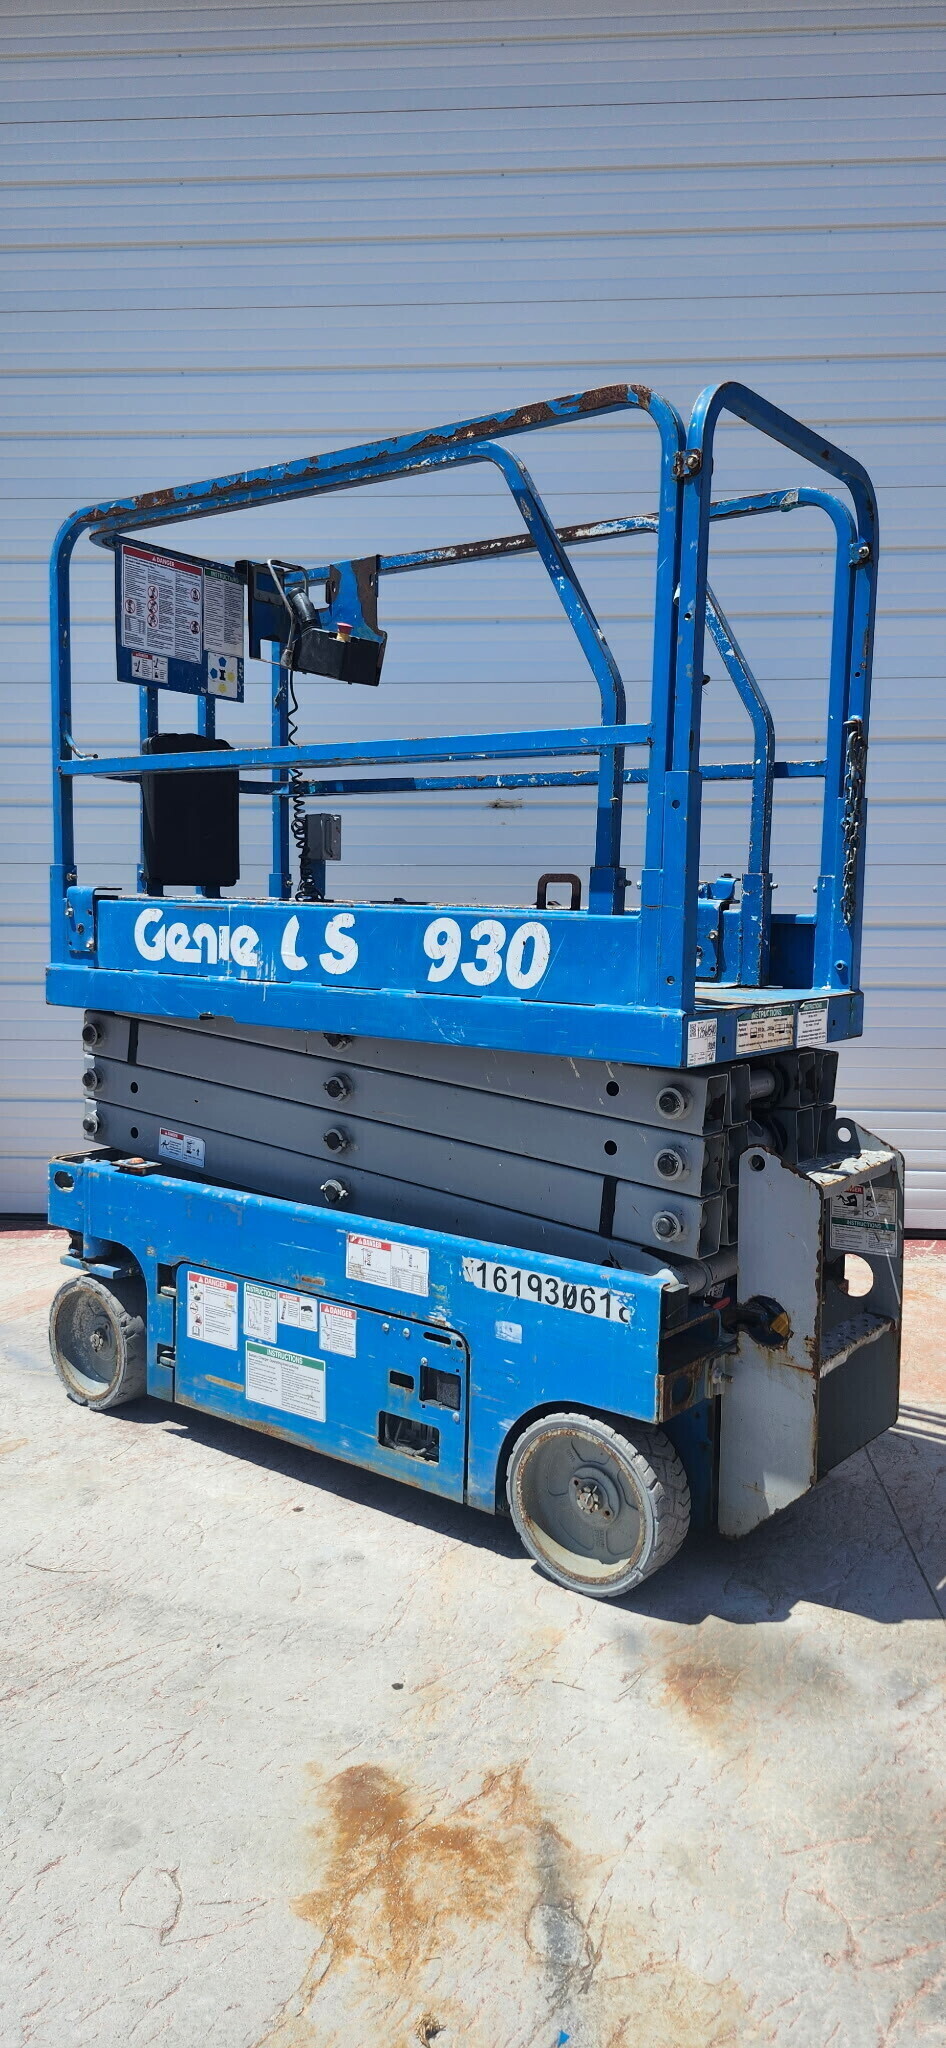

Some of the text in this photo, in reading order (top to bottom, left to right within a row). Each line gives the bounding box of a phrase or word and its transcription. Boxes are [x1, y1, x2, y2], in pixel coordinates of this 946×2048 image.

[156, 556, 175, 567] DANGER
[133, 907, 259, 967] Genie
[423, 917, 551, 990] 930
[846, 1219, 882, 1229] INSTRUCTIONS
[363, 1237, 381, 1249] DANGER
[204, 1276, 228, 1290] DANGER
[246, 1285, 276, 1298] INSTRUCTIONS
[329, 1306, 353, 1318] DANGER
[266, 1348, 303, 1365] INSTRUCTIONS
